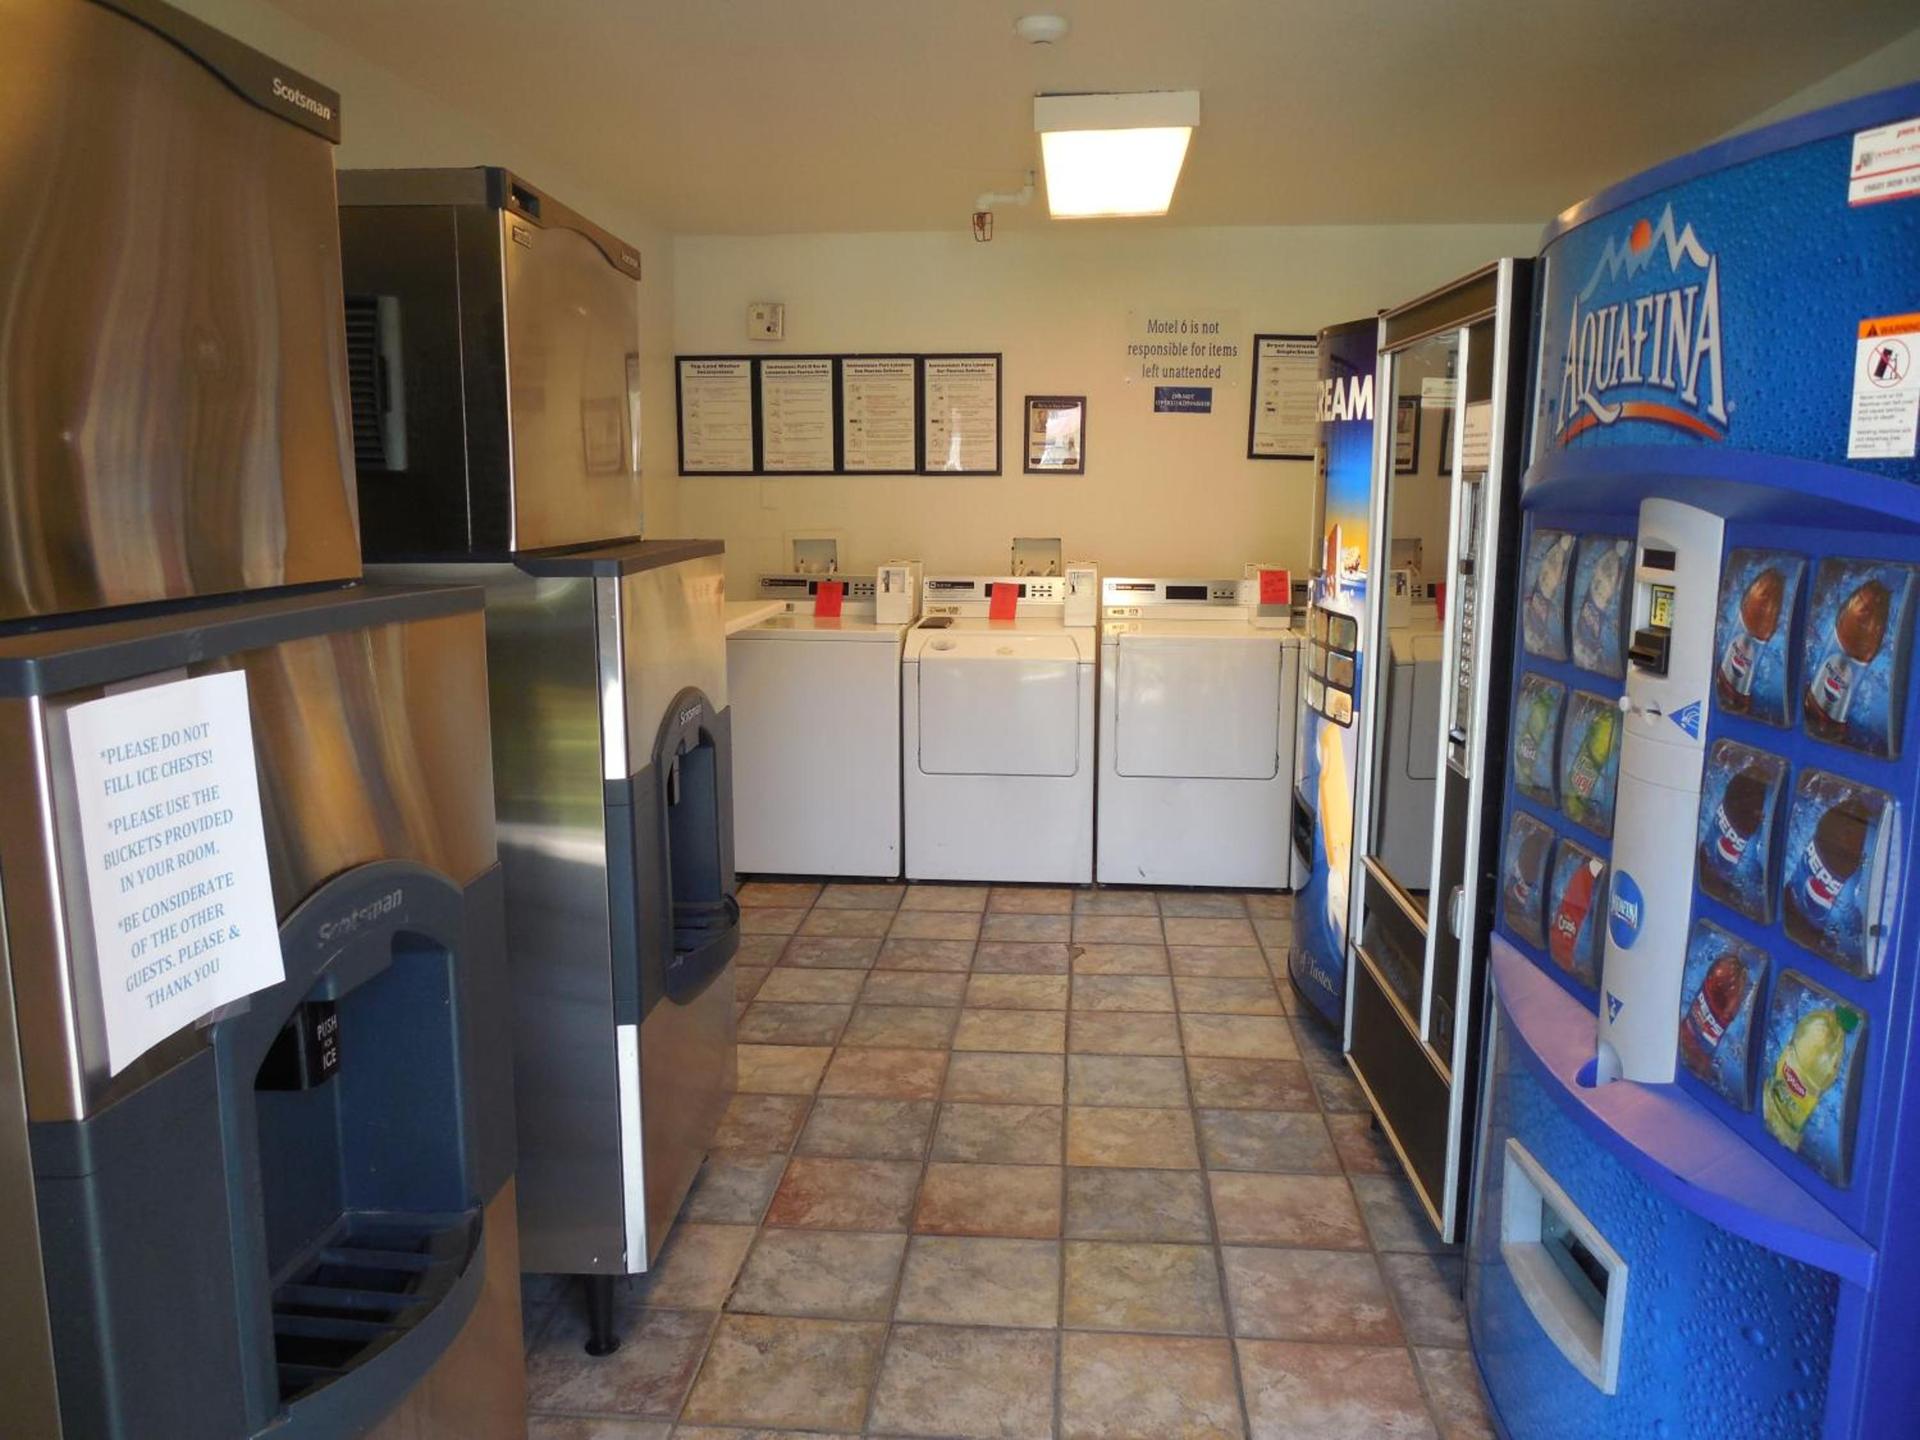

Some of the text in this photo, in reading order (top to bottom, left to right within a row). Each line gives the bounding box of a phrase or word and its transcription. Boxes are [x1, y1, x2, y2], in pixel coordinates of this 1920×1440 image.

[272, 77, 331, 120] Scotsman
[1128, 341, 1238, 359] responsible for items
[1147, 319, 1219, 334] Motel 6 is not
[1557, 252, 1728, 434] AQUAFINA
[1142, 363, 1221, 379] left unattended
[1315, 374, 1374, 421] REAM
[161, 730, 181, 750] DO
[183, 722, 210, 744] NOT
[104, 749, 213, 796] FILL ICE CHESTS!
[165, 794, 191, 817] USE
[192, 784, 221, 806] THE
[103, 808, 234, 871] BUCKETS PROVIDED
[1716, 802, 1747, 852] PEPS
[120, 840, 221, 893] IN YOUR ROOM.
[1806, 839, 1844, 896] PEPS
[142, 871, 236, 924] CONSIDERATE
[131, 902, 225, 959] OF THE OTHER
[125, 923, 241, 993] GUESTS. PLEASE &
[145, 957, 221, 1009] THANK YOU
[317, 1014, 337, 1041] PUSH
[323, 1047, 337, 1070] ICE
